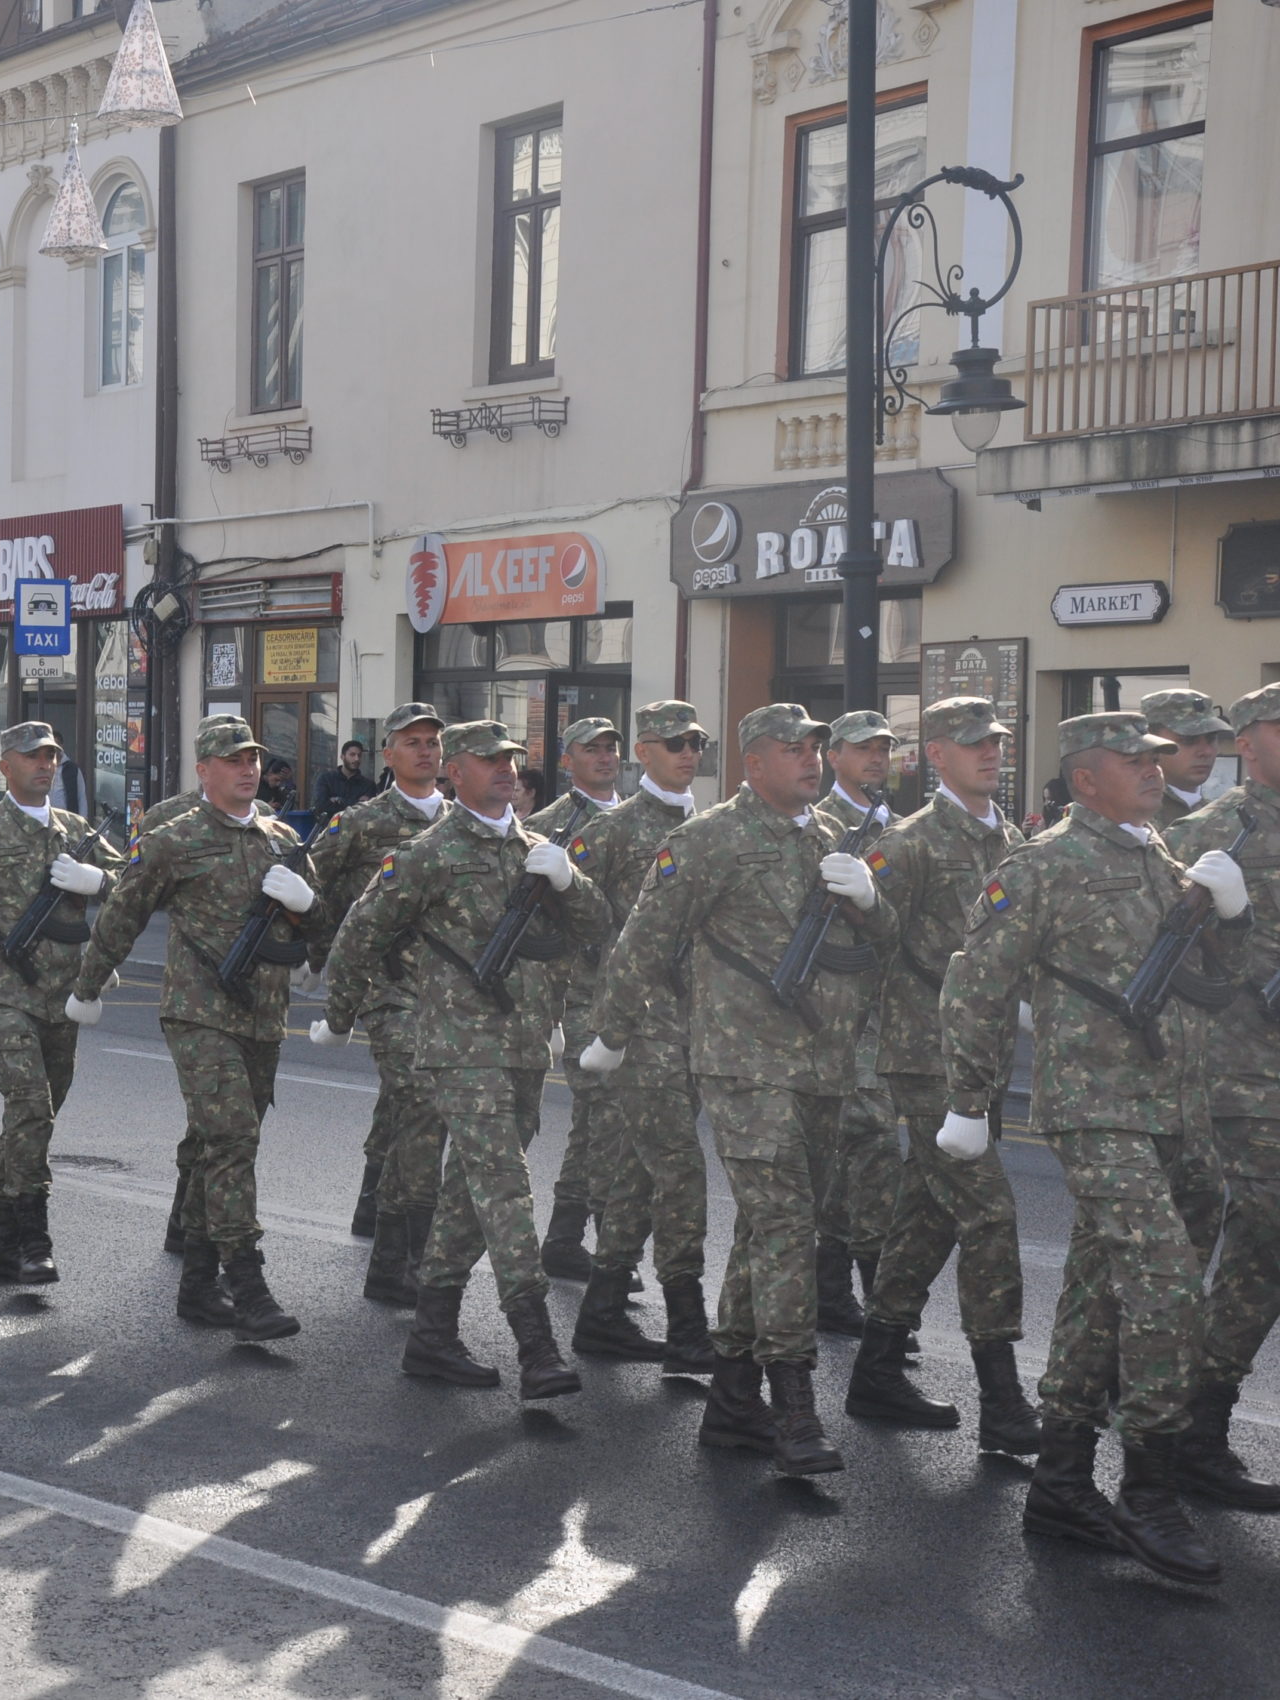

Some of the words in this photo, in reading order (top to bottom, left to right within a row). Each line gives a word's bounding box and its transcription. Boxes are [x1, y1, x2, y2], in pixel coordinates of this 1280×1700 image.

[756, 518, 920, 579] ROAA
[450, 545, 555, 598] ALKEEF
[693, 564, 730, 590] pepsi
[561, 592, 585, 606] pepsi
[1069, 593, 1143, 614] MARKET
[25, 633, 58, 646] TAXI
[38, 657, 45, 667] 6
[955, 660, 988, 672] ROATA
[25, 667, 58, 677] LOCURI
